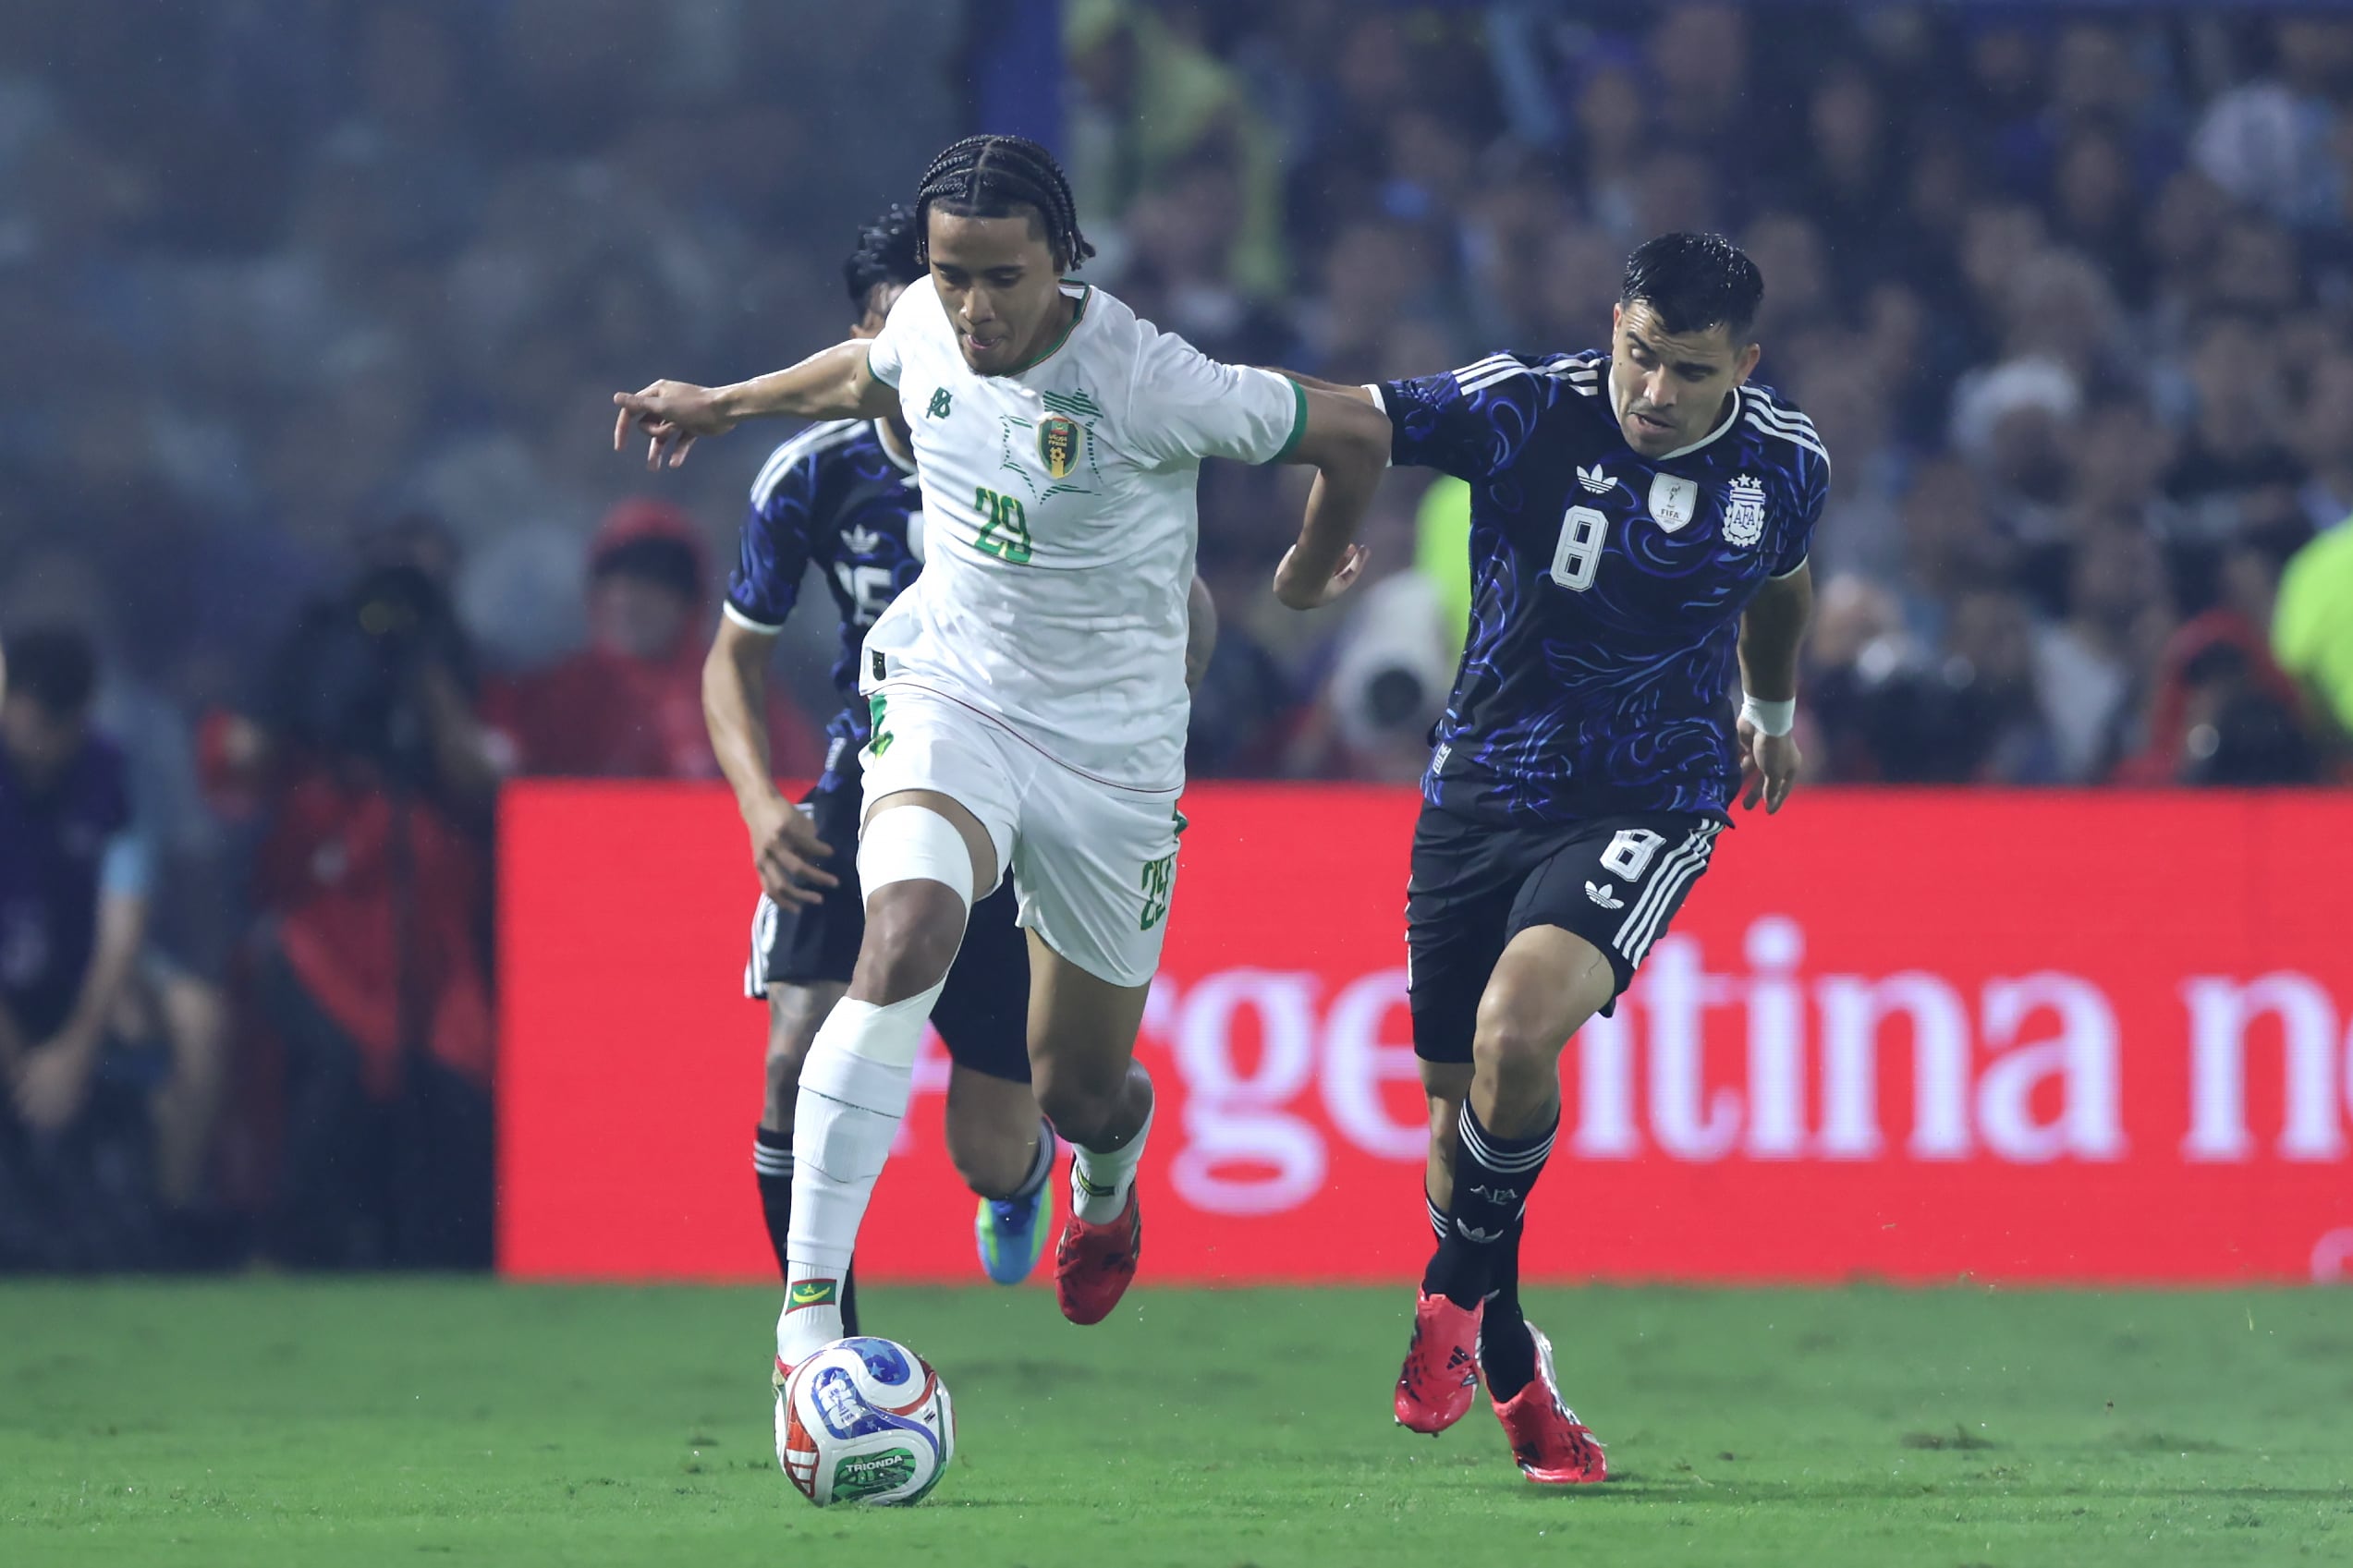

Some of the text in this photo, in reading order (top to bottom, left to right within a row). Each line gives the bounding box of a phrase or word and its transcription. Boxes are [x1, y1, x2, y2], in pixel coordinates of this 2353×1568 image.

[975, 486, 1031, 564] 29
[1661, 508, 1679, 518] FIFA
[1733, 504, 1755, 530] AFA
[1550, 504, 1609, 592] 8
[834, 560, 892, 626] 15
[1599, 828, 1667, 882] 8
[1140, 854, 1172, 931] 29
[884, 914, 2353, 1217] getina n
[846, 1454, 903, 1473] TRIONDA
